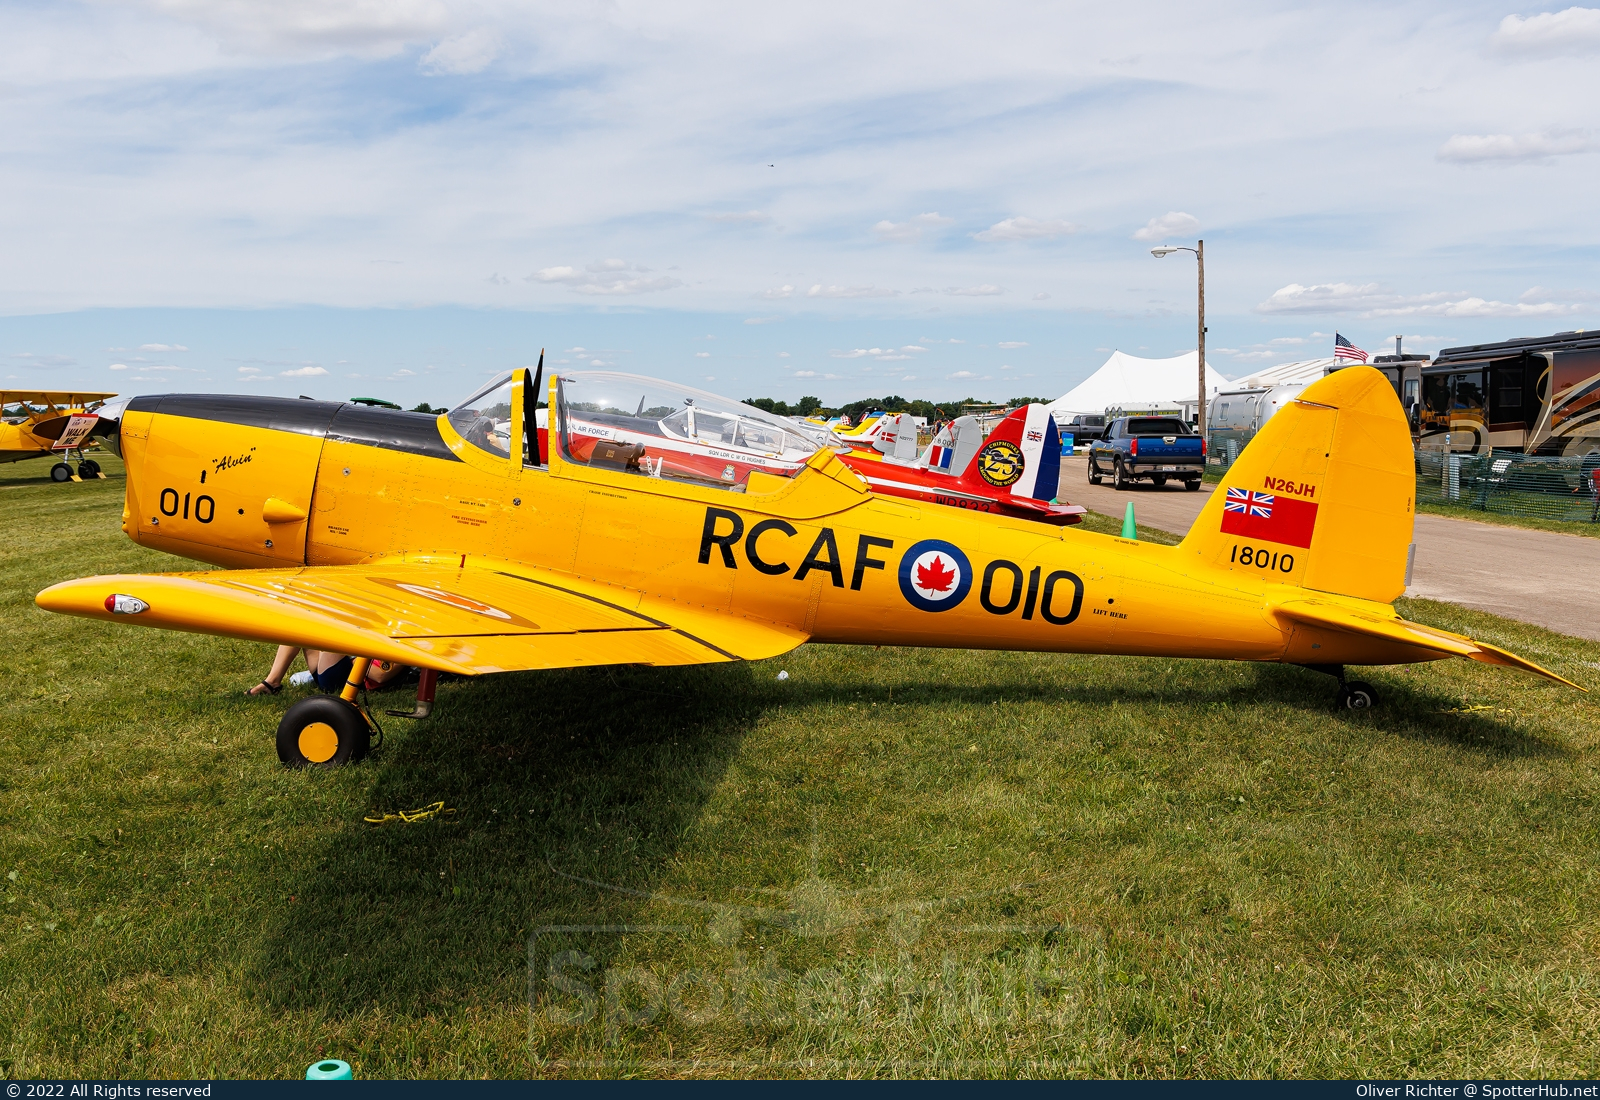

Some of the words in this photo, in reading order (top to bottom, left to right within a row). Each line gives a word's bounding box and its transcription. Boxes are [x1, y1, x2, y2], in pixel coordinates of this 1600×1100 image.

[66, 428, 89, 437] WALK
[588, 427, 610, 437] FORCE
[62, 437, 77, 445] ME
[988, 441, 1021, 455] CHIPMUNKS
[747, 456, 766, 465] HUGHES
[1003, 473, 1020, 486] WORLD
[1264, 476, 1316, 498] N26JH
[160, 488, 215, 524] 010
[698, 507, 894, 591] RCAF
[1231, 545, 1294, 573] 18010
[980, 559, 1084, 625] 010
[1110, 611, 1128, 619] HERE
